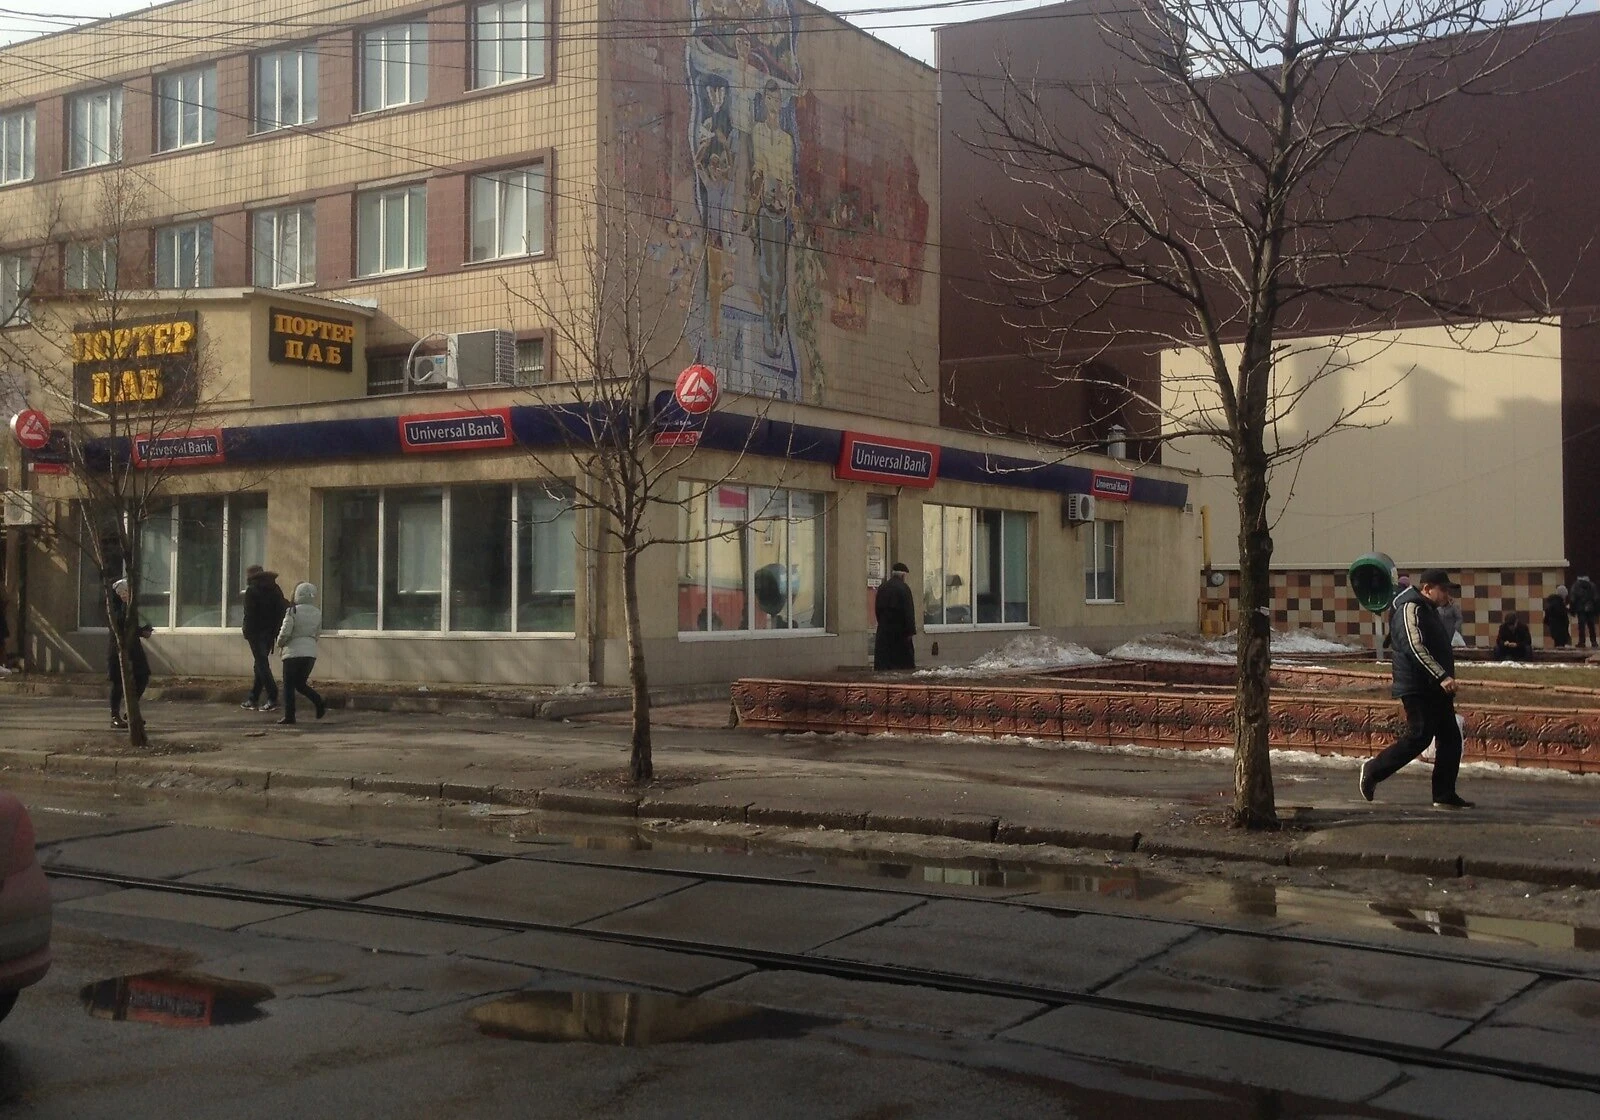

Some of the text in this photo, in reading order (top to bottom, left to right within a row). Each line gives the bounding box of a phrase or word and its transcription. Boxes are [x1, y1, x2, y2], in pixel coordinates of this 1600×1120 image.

[274, 314, 356, 343] ПОРТЕР
[72, 321, 194, 363] ПОРТЕР
[285, 340, 341, 365] ПАБ
[92, 367, 163, 404] ПАБ
[410, 421, 500, 441] Universal Bank
[188, 440, 214, 453] Bank
[856, 448, 927, 473] Universal Bank
[1096, 478, 1128, 492] Universal Bank
